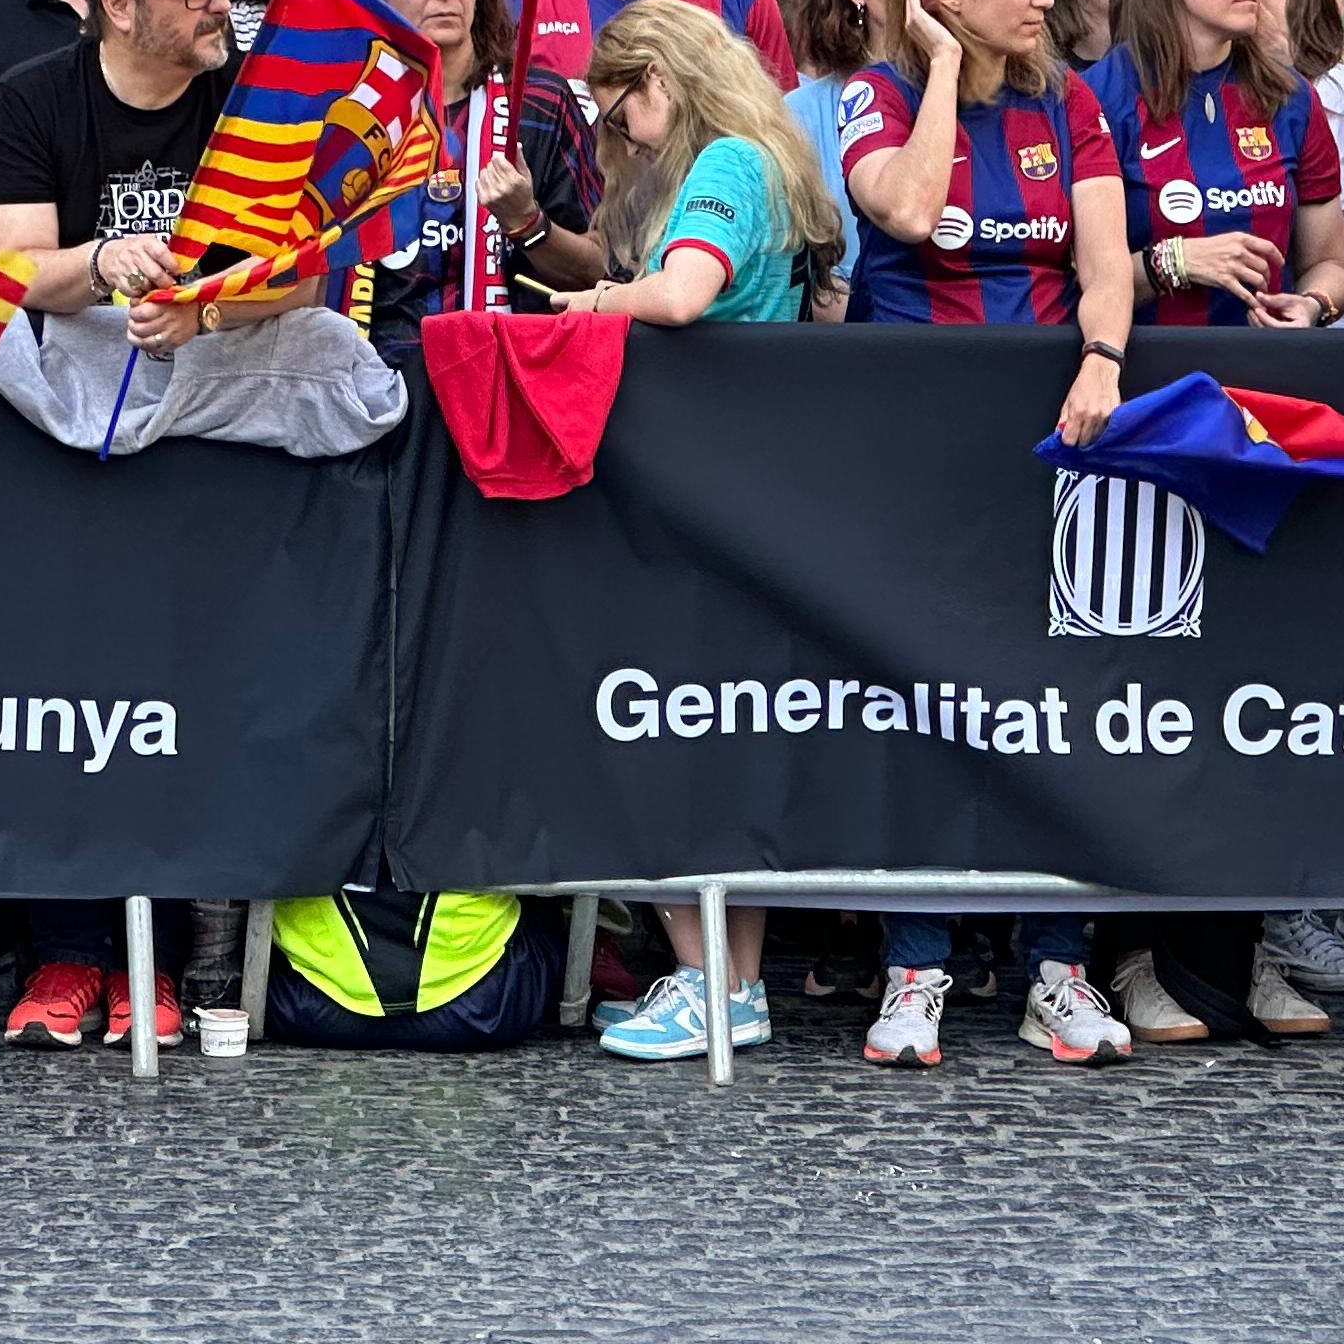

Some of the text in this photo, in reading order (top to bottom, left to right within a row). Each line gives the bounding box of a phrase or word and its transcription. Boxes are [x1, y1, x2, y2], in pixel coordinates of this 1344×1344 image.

[537, 21, 580, 36] BARÇA
[110, 183, 185, 229] LORD
[686, 199, 735, 220] BIMBO
[1206, 180, 1285, 213] Spotify
[131, 220, 150, 232] OF
[980, 216, 1068, 243] Spotify
[596, 668, 1071, 755] Generalitat
[1095, 682, 1194, 755] de
